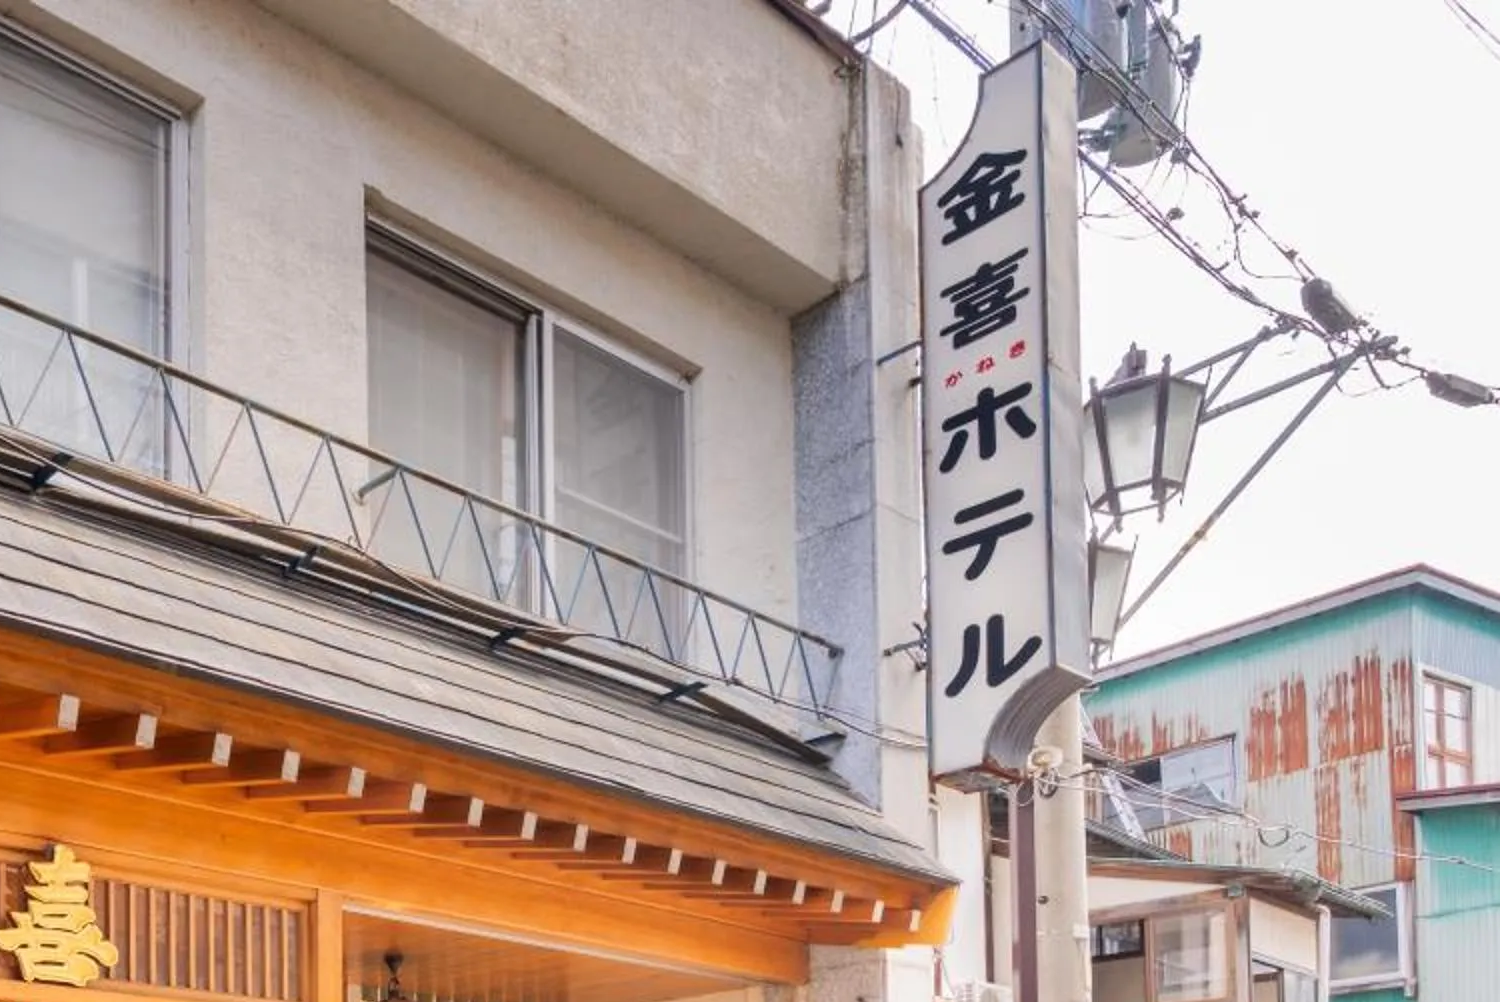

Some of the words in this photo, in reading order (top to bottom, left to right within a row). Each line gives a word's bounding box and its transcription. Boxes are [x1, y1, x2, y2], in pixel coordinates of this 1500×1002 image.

[937, 149, 1043, 698] 金喜ホテル
